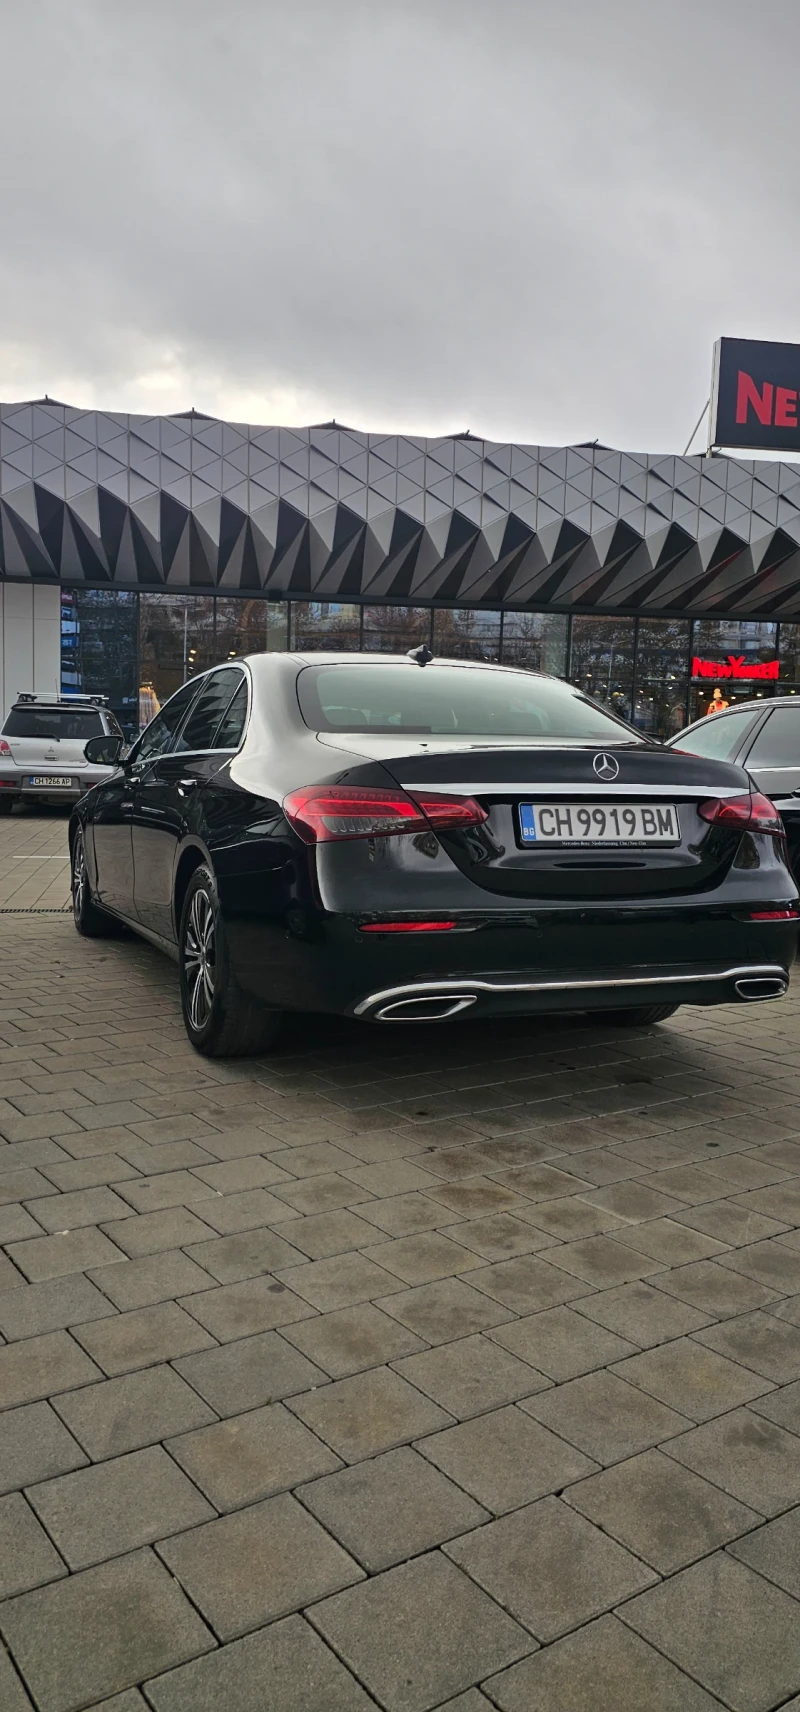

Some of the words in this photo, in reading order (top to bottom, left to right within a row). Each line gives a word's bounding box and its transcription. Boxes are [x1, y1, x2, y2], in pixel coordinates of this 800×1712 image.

[735, 369, 800, 427] NE
[524, 828, 534, 836] BG
[538, 808, 572, 836] CH
[576, 808, 636, 836] 9919
[641, 809, 674, 836] BM
